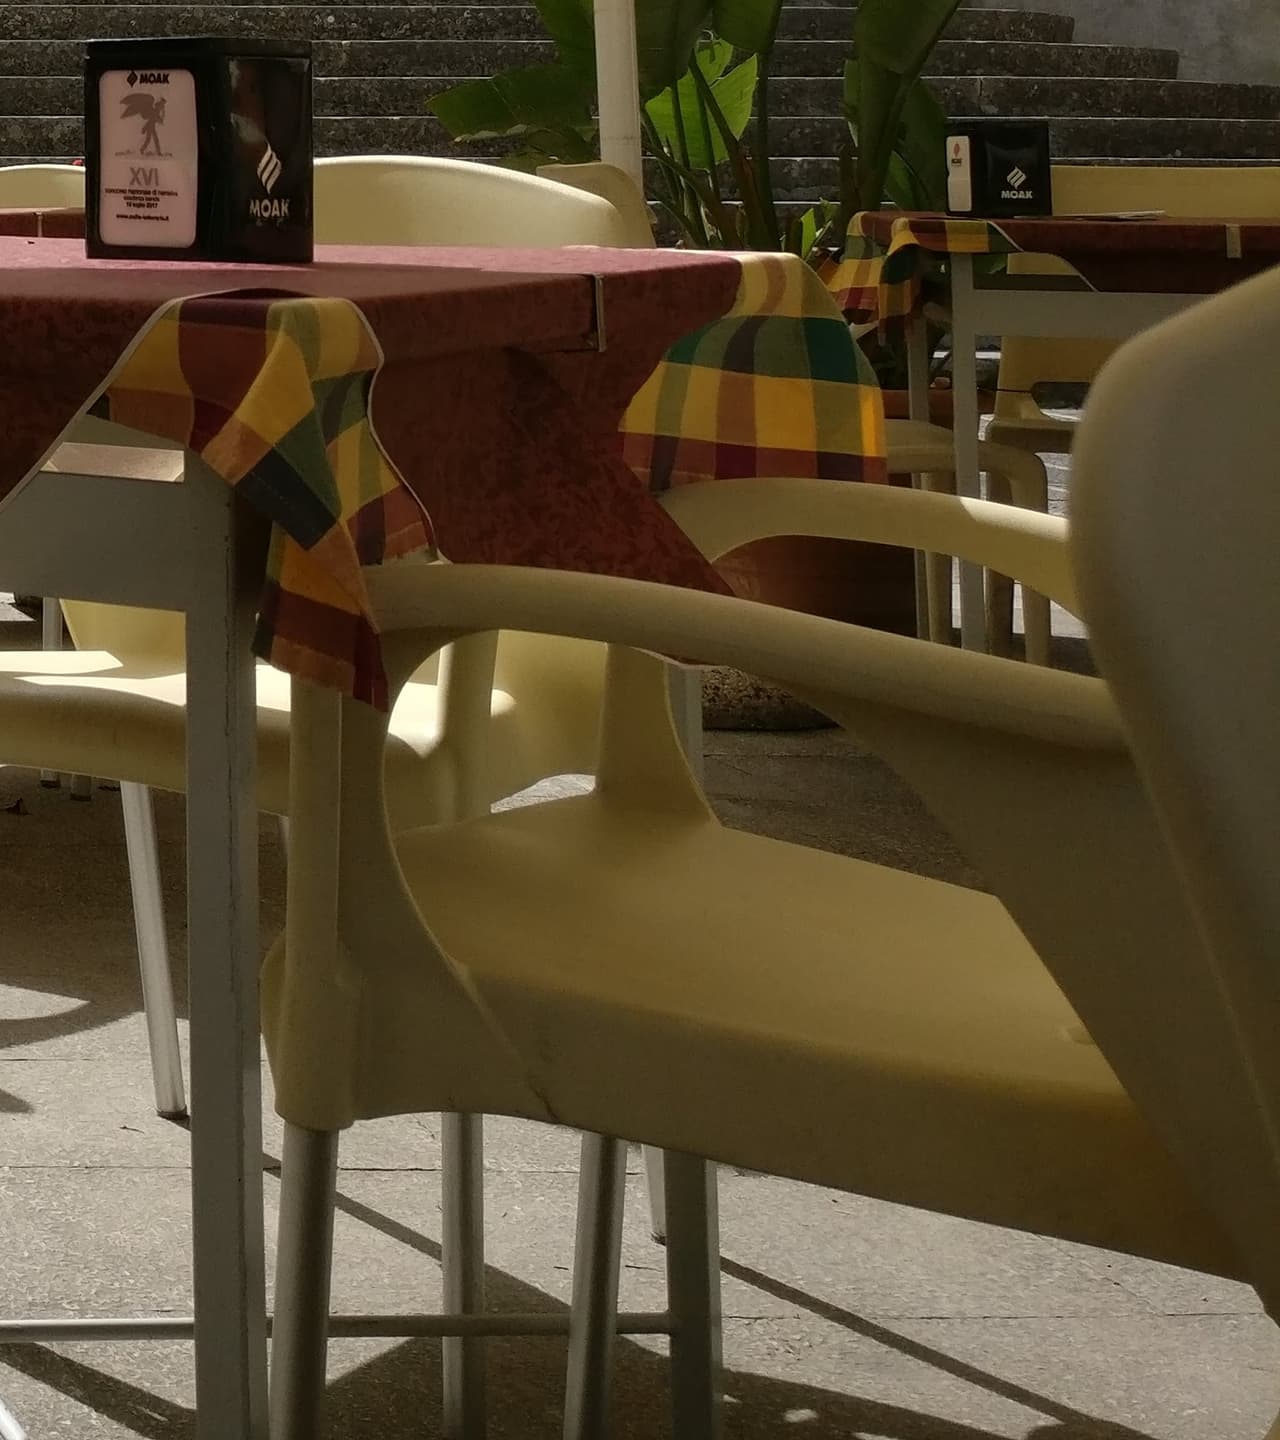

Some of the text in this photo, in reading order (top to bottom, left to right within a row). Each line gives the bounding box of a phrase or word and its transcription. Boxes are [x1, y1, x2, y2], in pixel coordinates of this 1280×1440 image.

[139, 73, 170, 85] MOAK
[129, 167, 160, 187] XVI
[1001, 190, 1033, 199] MOAK
[249, 199, 290, 218] MOAK
